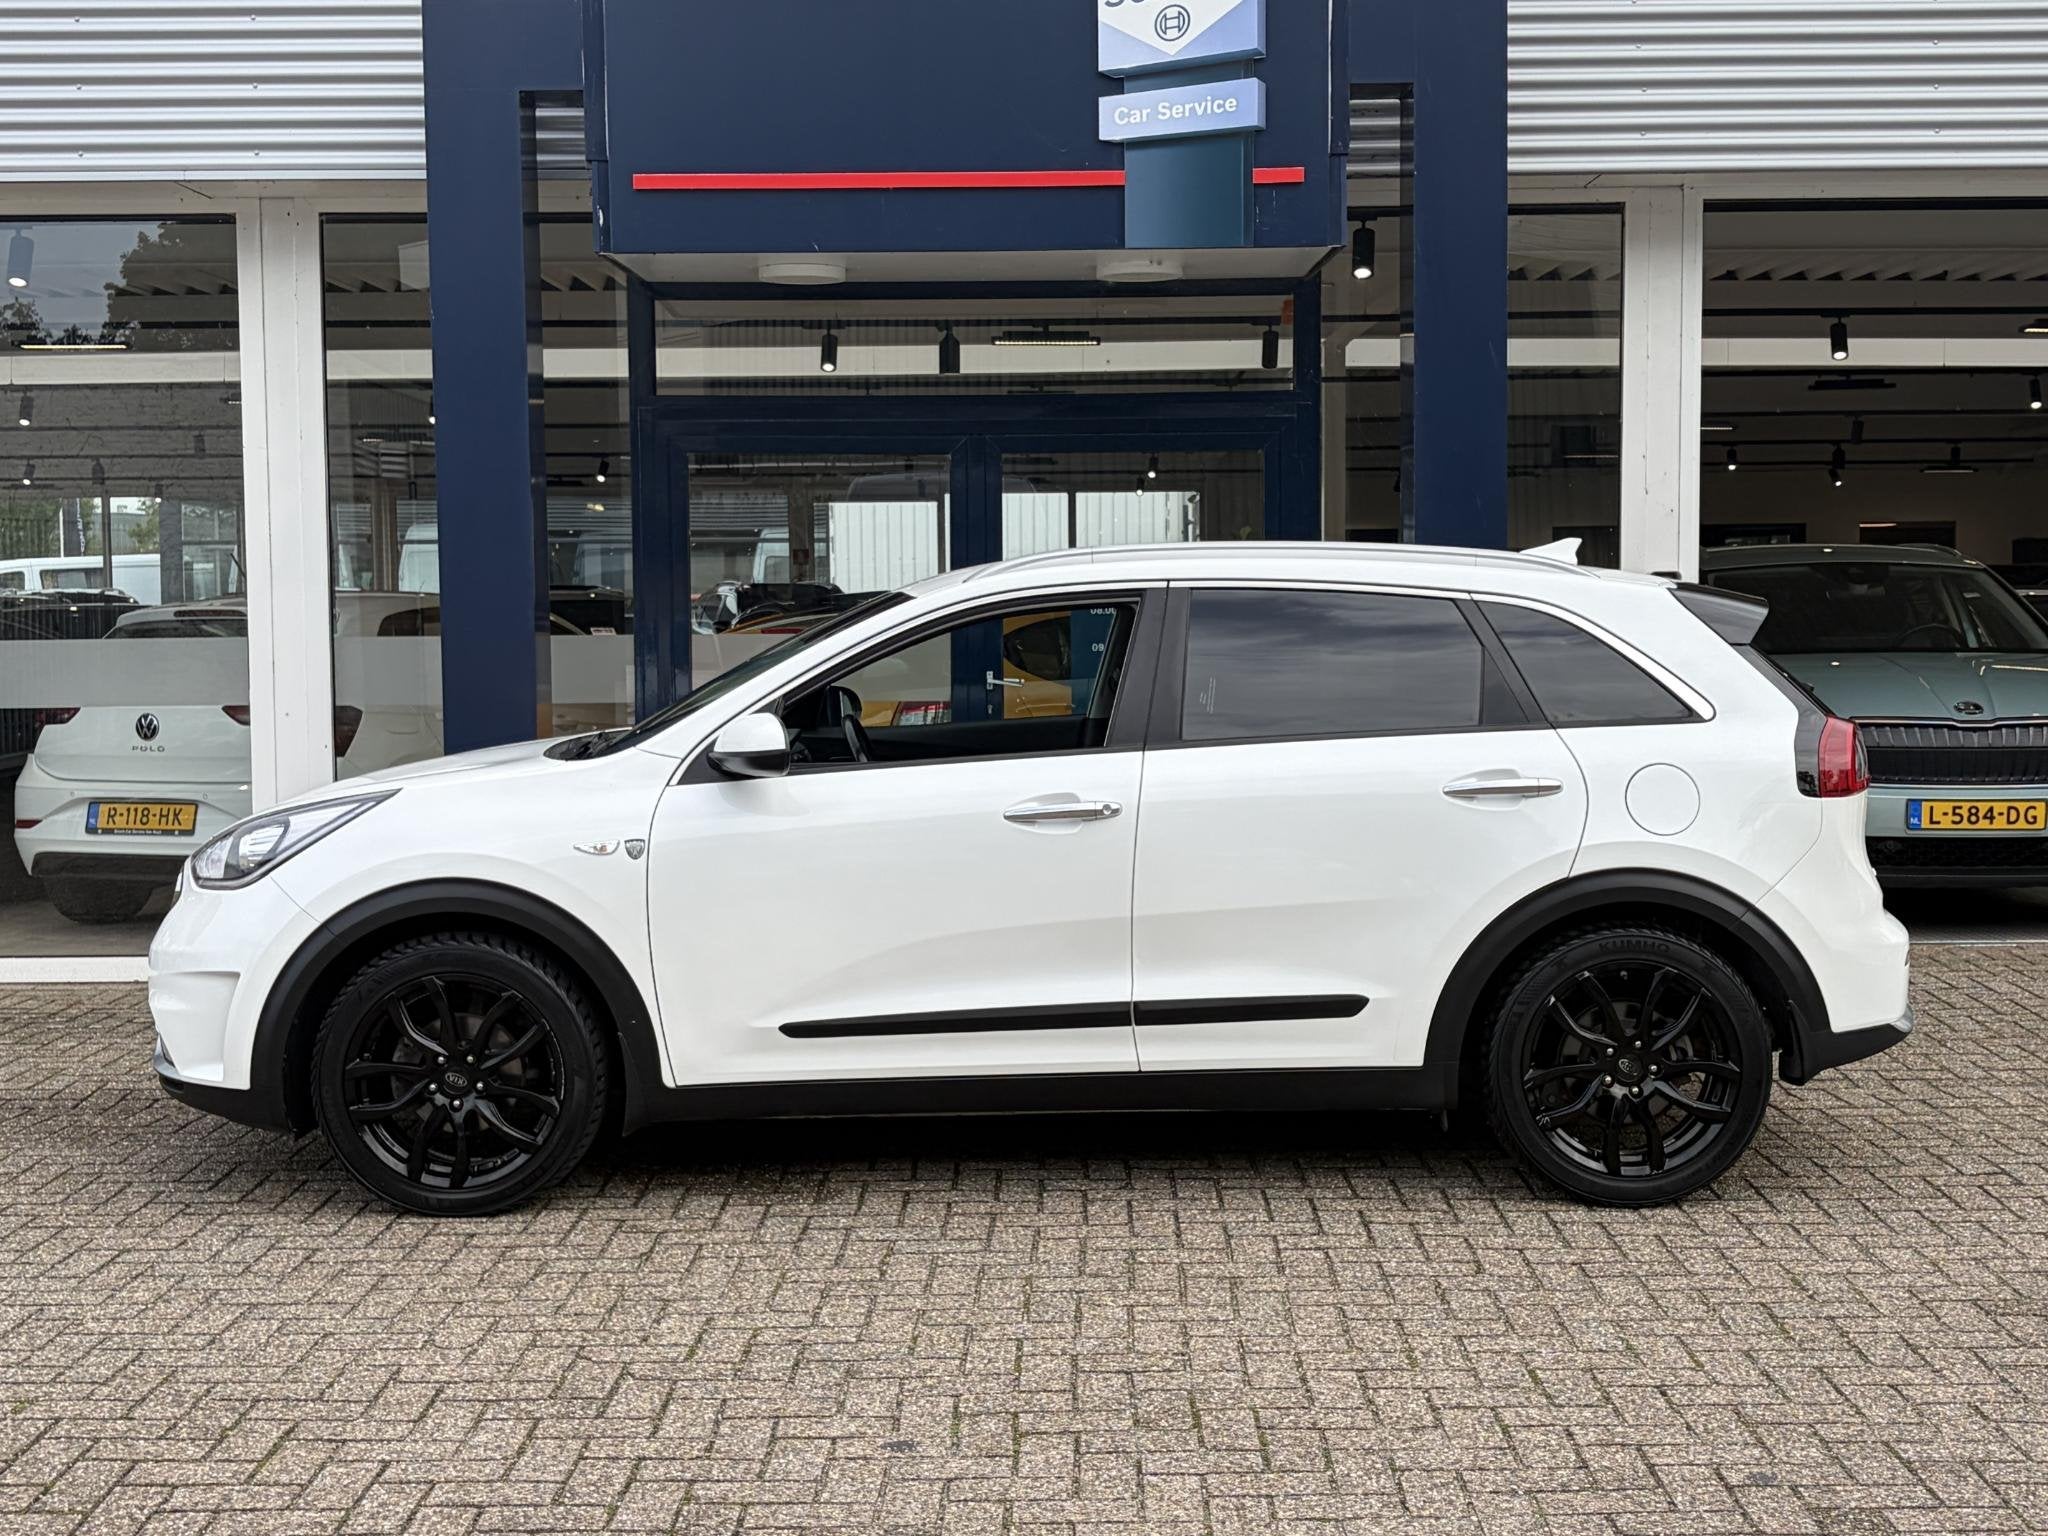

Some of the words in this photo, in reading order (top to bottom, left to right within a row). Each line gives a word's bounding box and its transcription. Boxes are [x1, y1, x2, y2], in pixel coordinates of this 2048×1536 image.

[1114, 107, 1151, 125] Car
[1157, 96, 1238, 120] Service
[132, 745, 165, 753] POLO
[106, 806, 183, 826] R-118-HK
[1929, 805, 2038, 825] L-584-DG
